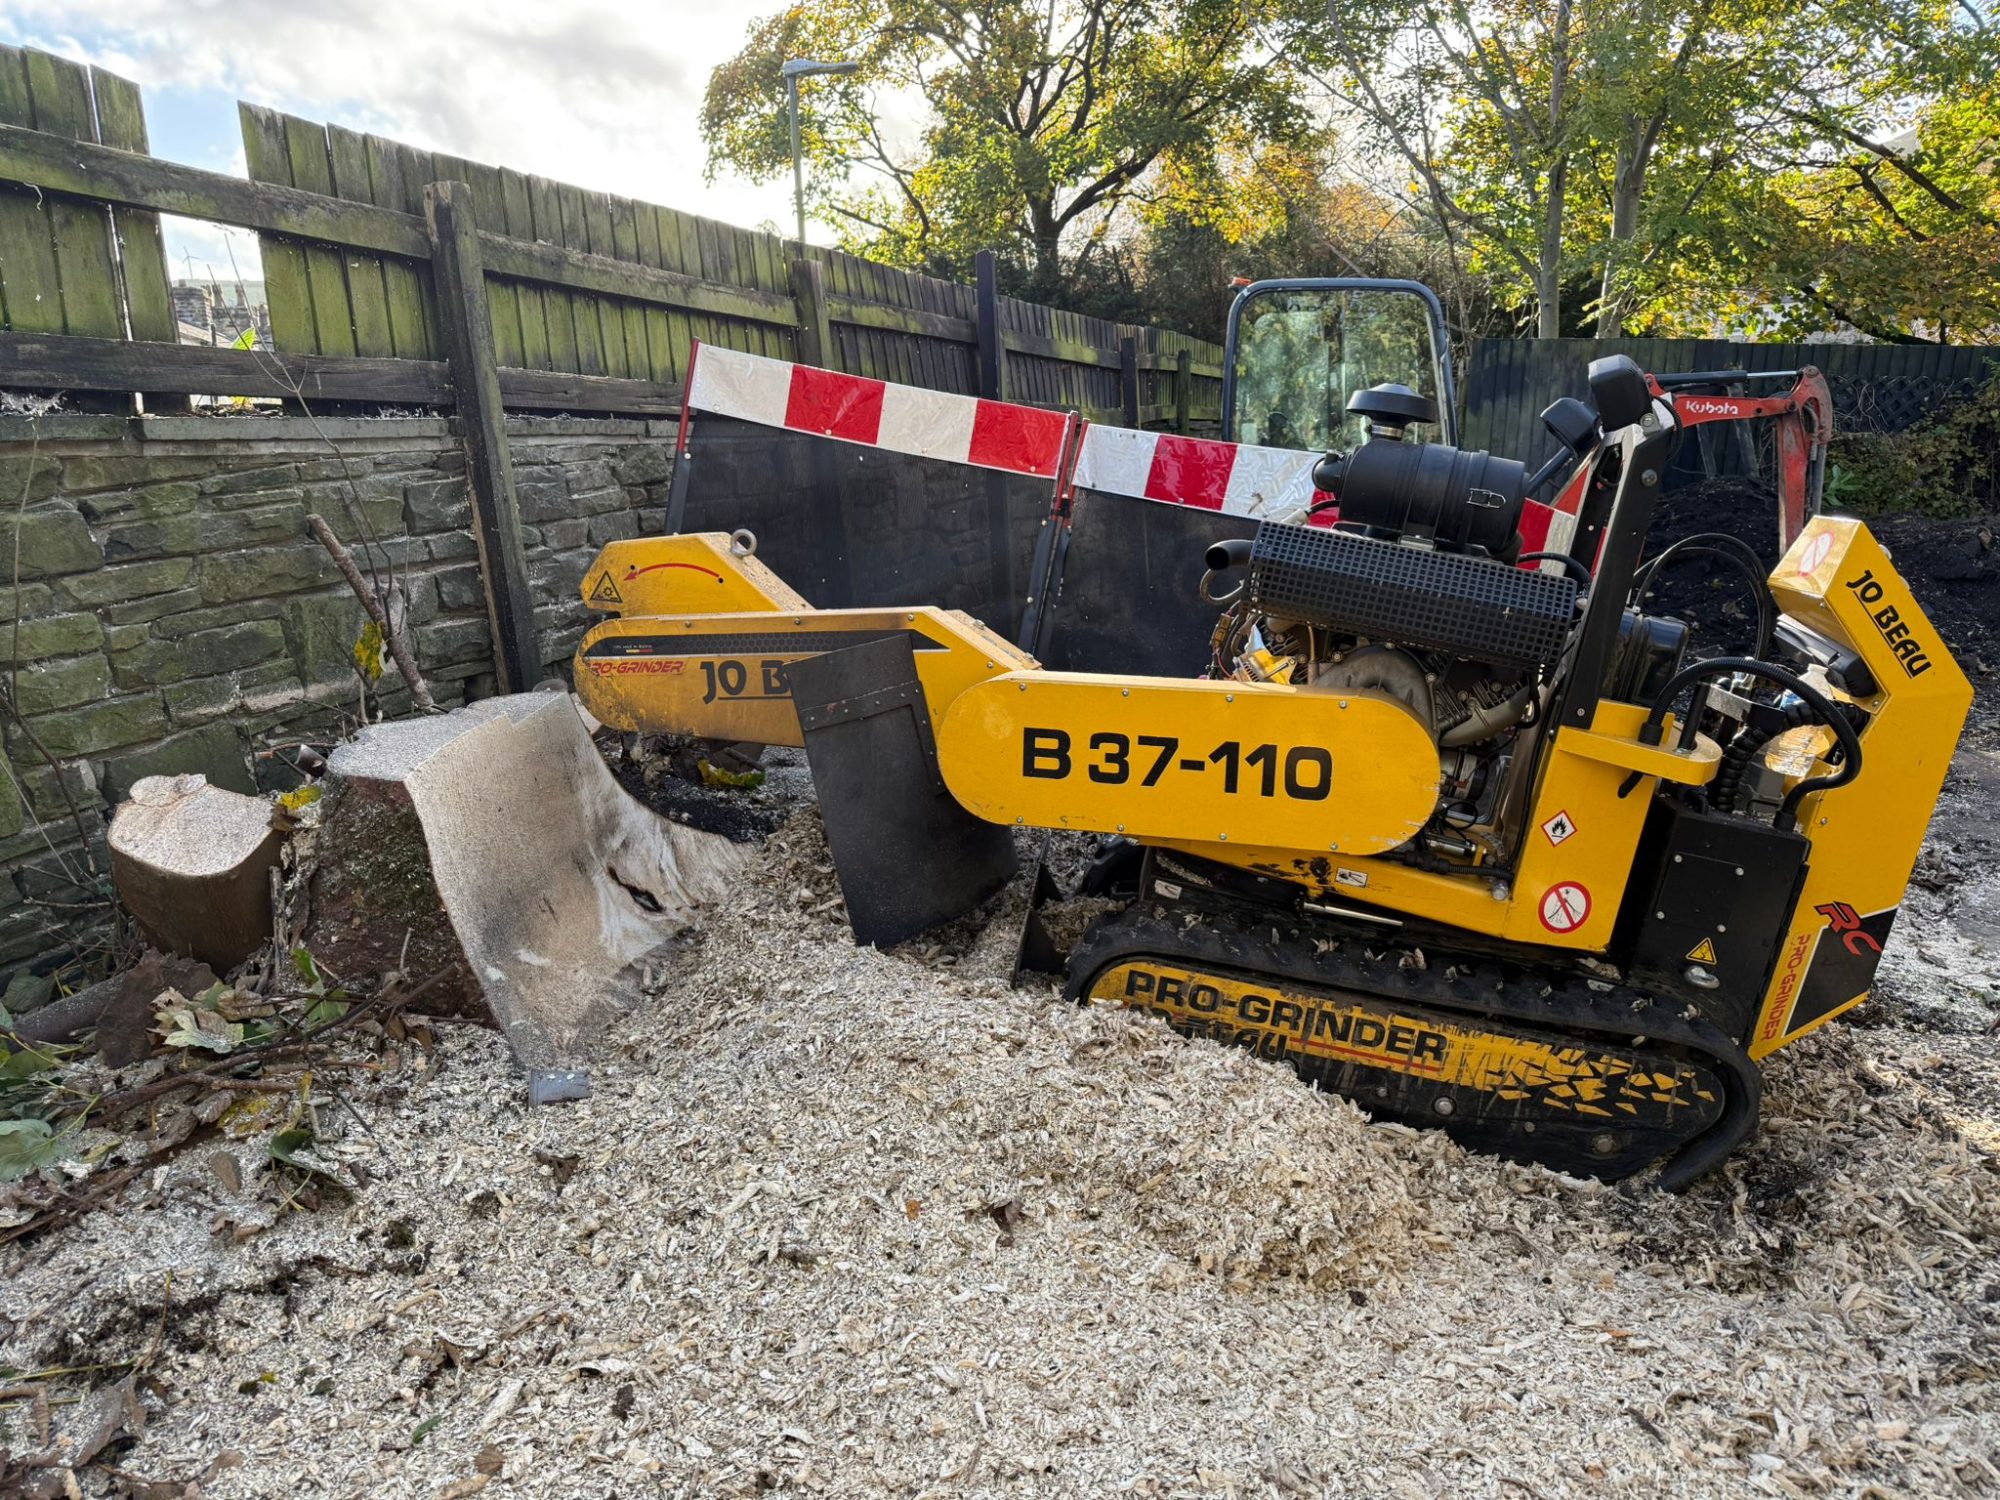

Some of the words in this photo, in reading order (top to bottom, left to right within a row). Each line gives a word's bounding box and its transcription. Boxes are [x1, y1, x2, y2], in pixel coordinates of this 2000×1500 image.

[1685, 400, 1738, 415] Kubota
[1846, 569, 1883, 603] JO
[1873, 604, 1932, 677] BEAU
[588, 660, 684, 675] RO-GRINDER
[700, 660, 746, 705] JO
[1022, 726, 1072, 780] B
[1087, 731, 1333, 802] 37-110
[1813, 901, 1884, 956] RC
[1125, 970, 1448, 1062] PRO-GRINDER
[1761, 934, 1810, 1041] PRO-GRINDER
